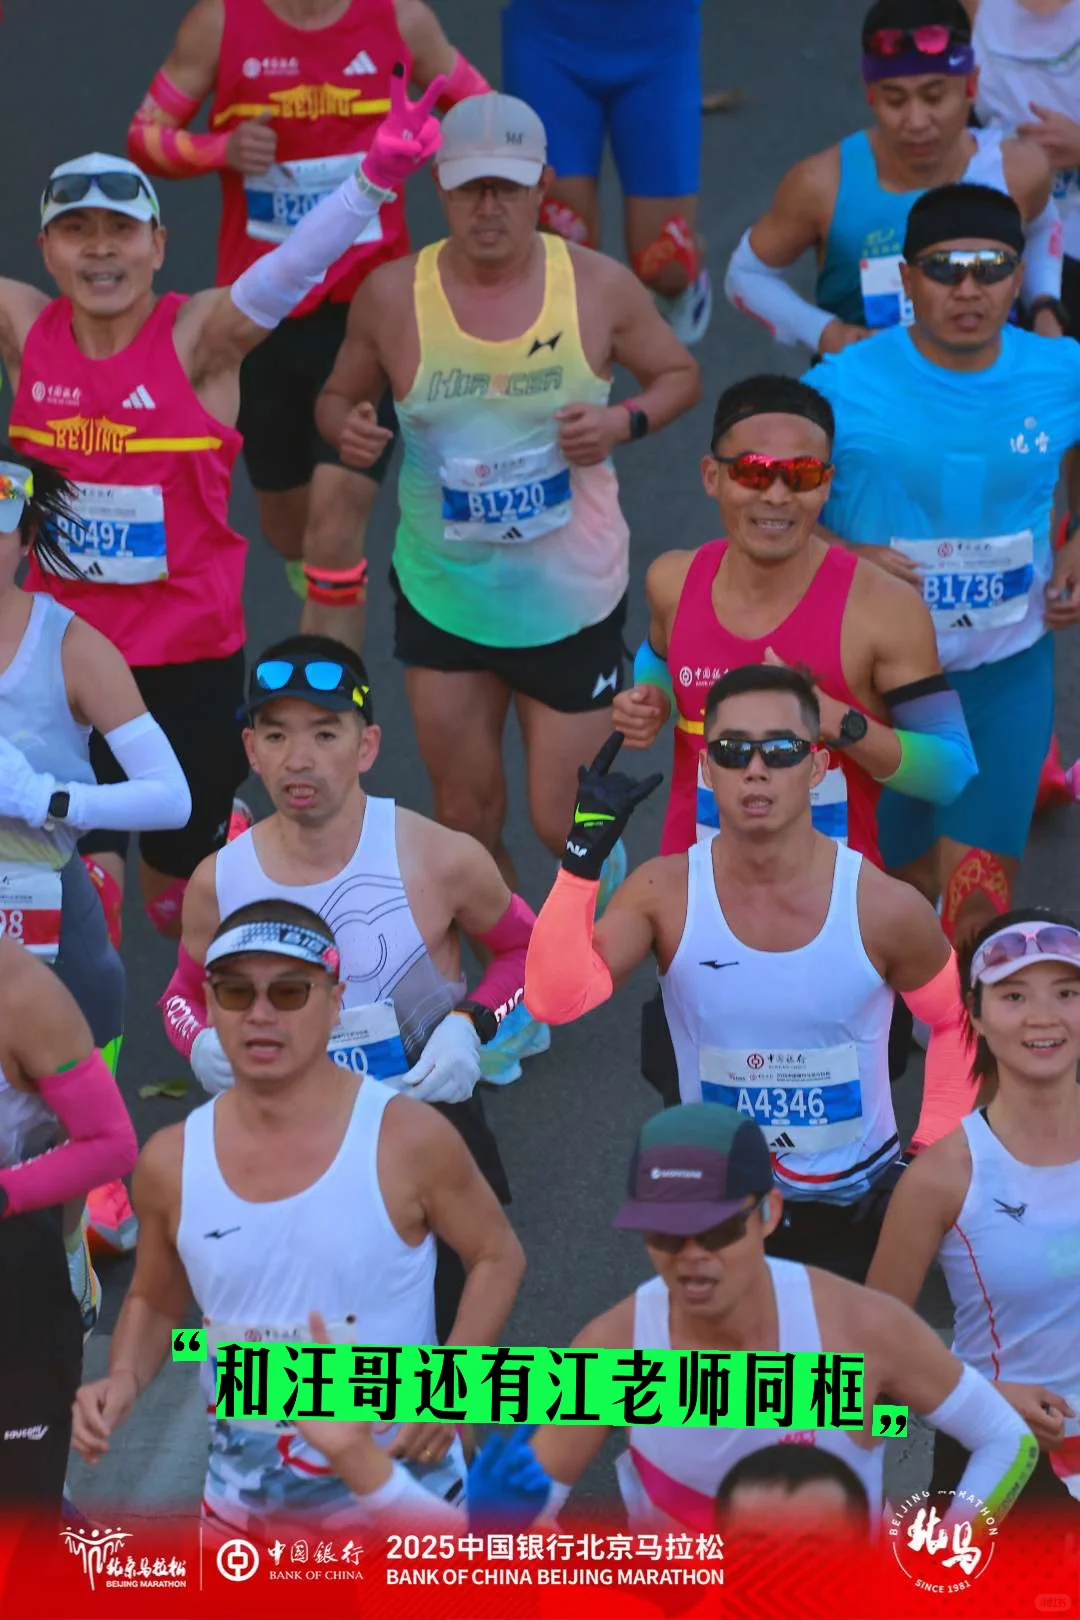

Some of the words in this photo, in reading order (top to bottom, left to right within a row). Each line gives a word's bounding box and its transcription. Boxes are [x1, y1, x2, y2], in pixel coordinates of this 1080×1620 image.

[54, 415, 124, 456] BEIJING
[467, 483, 545, 518] B1220
[923, 573, 1005, 604] B1736
[736, 1087, 825, 1119] A4346
